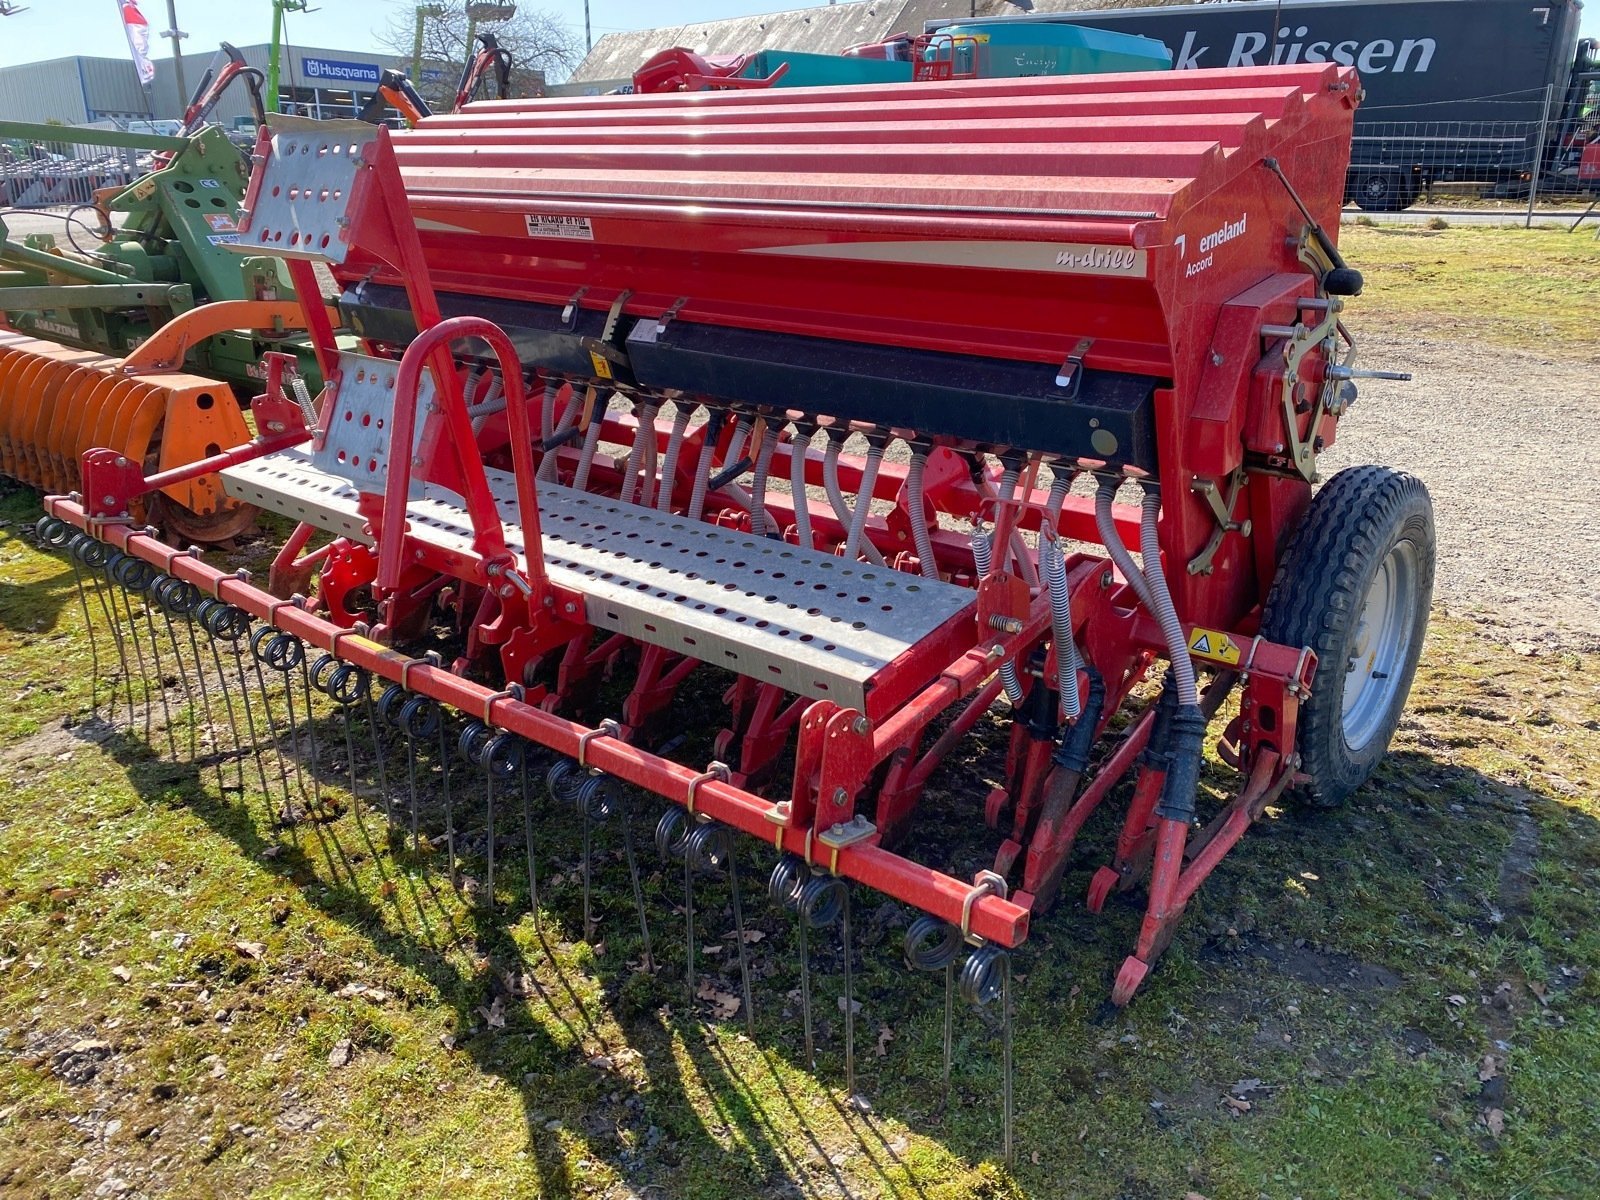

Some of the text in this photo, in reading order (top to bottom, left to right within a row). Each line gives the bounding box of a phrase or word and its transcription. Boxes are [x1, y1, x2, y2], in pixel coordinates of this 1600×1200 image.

[320, 63, 377, 79] Husqvarna
[1055, 247, 1136, 270] m-drill
[1186, 253, 1213, 278] Accord
